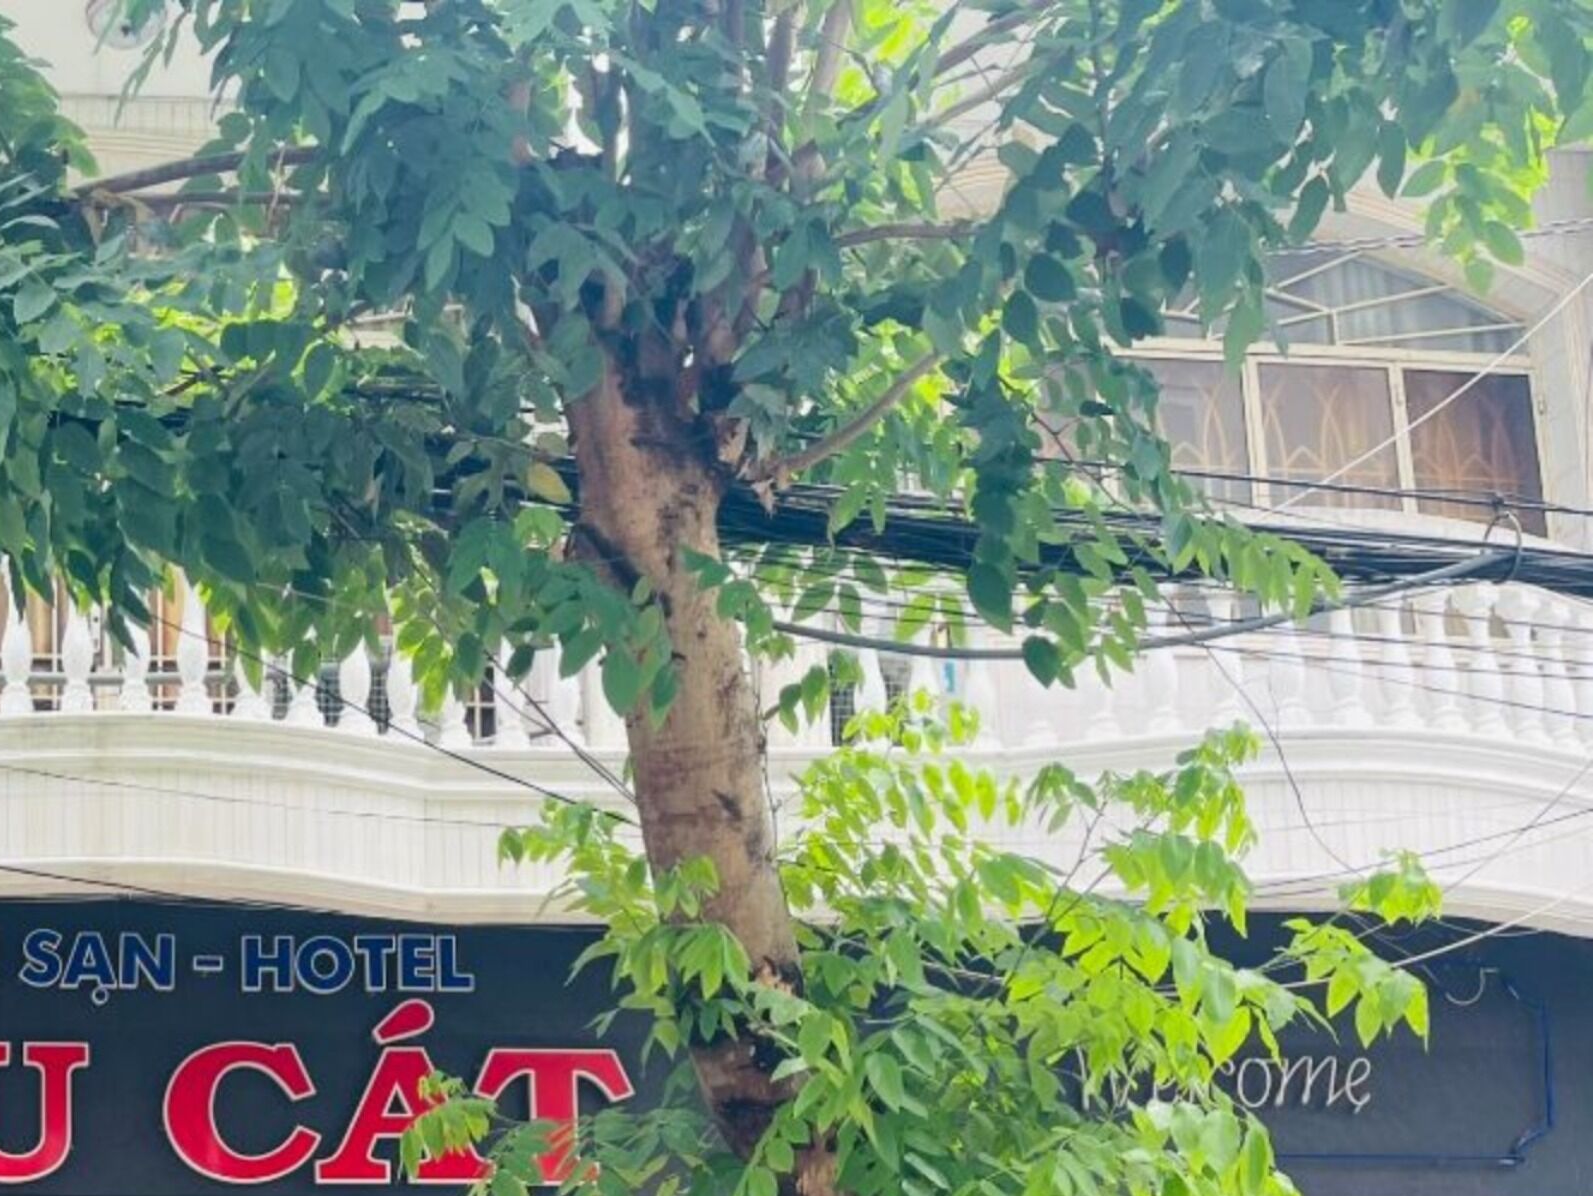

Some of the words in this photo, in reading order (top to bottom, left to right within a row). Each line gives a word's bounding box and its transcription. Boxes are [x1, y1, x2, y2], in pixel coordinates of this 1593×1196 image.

[19, 928, 176, 1004] SẠN
[192, 954, 224, 972] -
[241, 934, 475, 994] HOTEL
[162, 998, 636, 1184] CÁT
